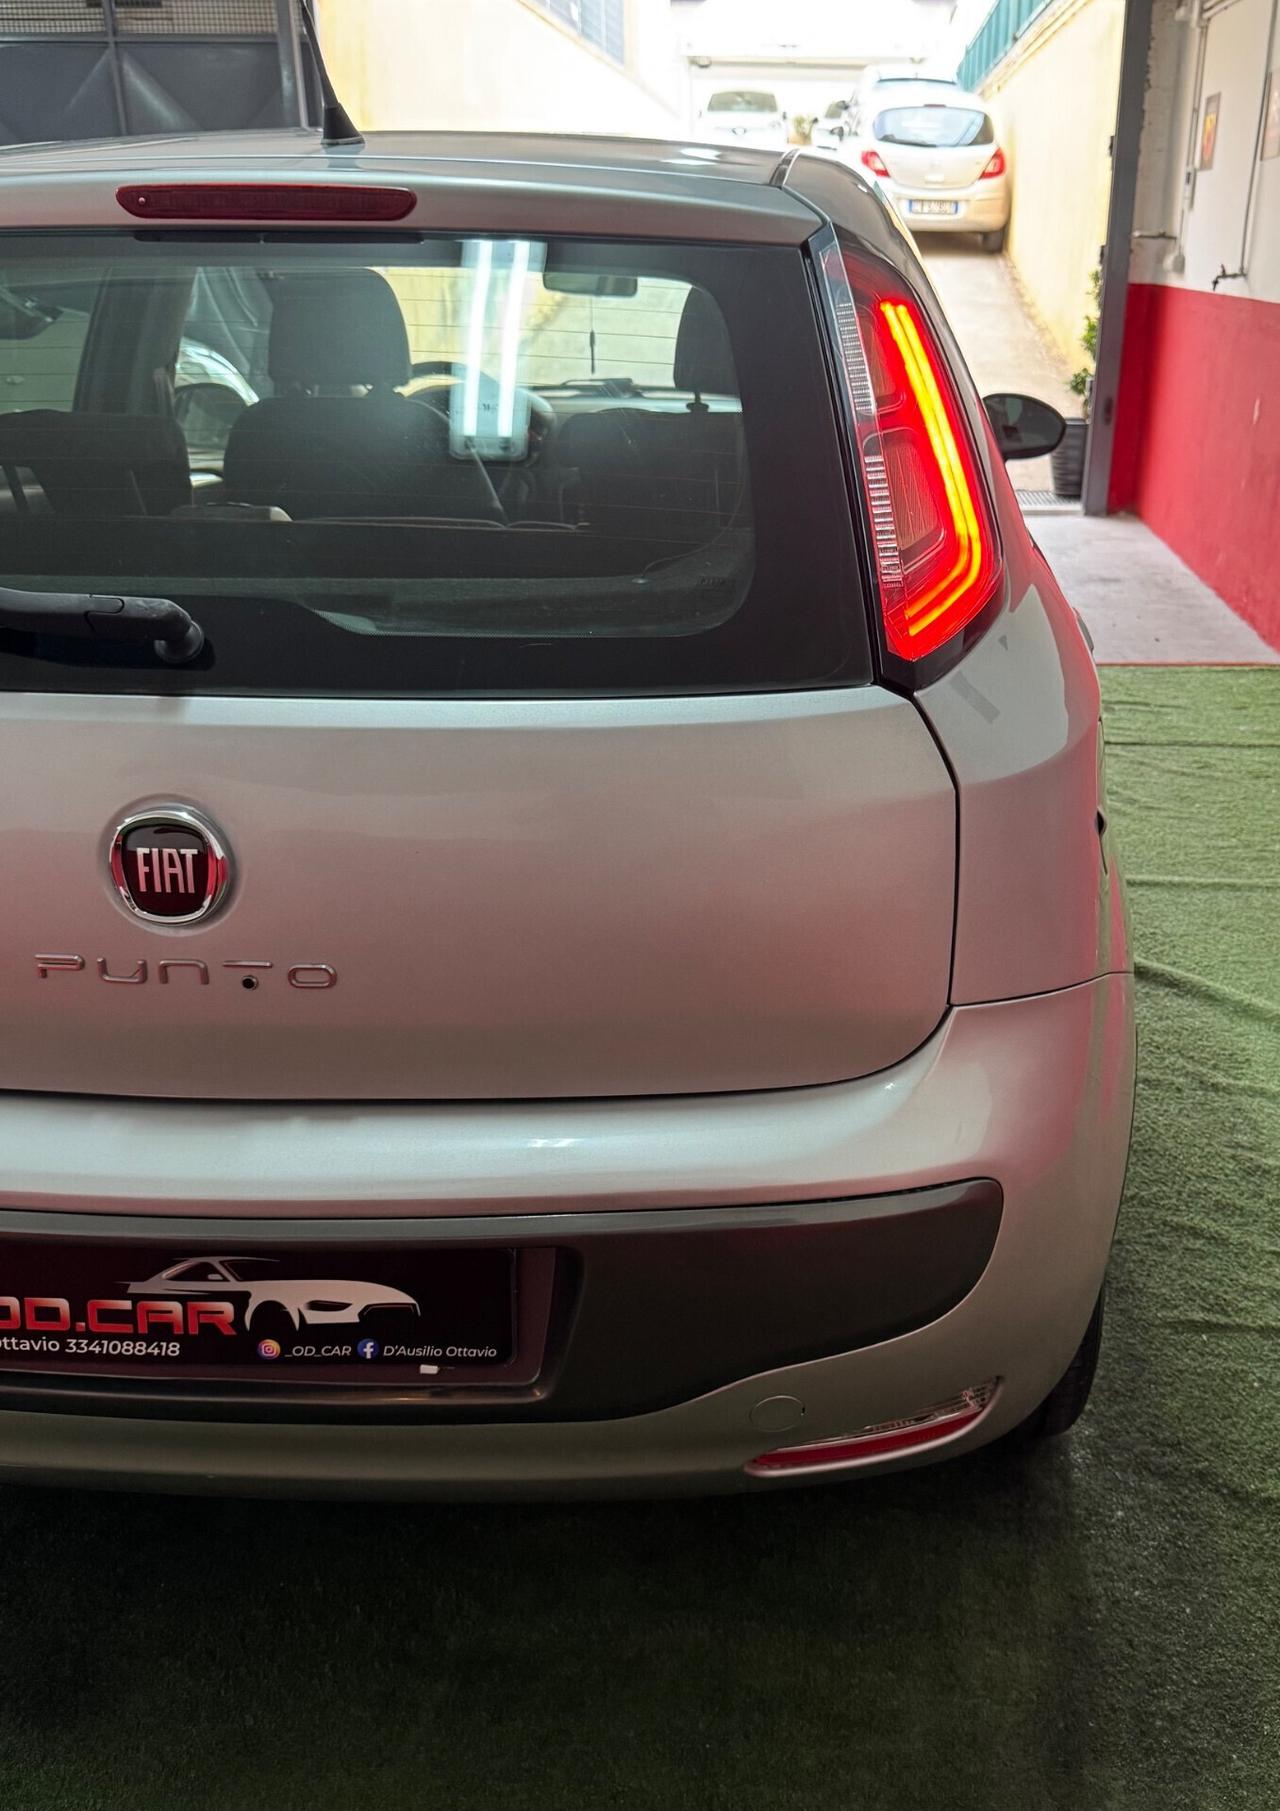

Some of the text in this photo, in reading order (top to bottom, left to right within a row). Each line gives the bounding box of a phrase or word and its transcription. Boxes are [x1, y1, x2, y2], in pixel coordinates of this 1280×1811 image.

[136, 847, 198, 894] FIAT
[34, 952, 338, 989] PUNTO
[0, 1336, 180, 1357] ttavio 3341088418
[284, 1345, 352, 1357] _OD_CAR
[383, 1345, 443, 1357] D'Ausilio
[446, 1346, 497, 1358] Ottavio
